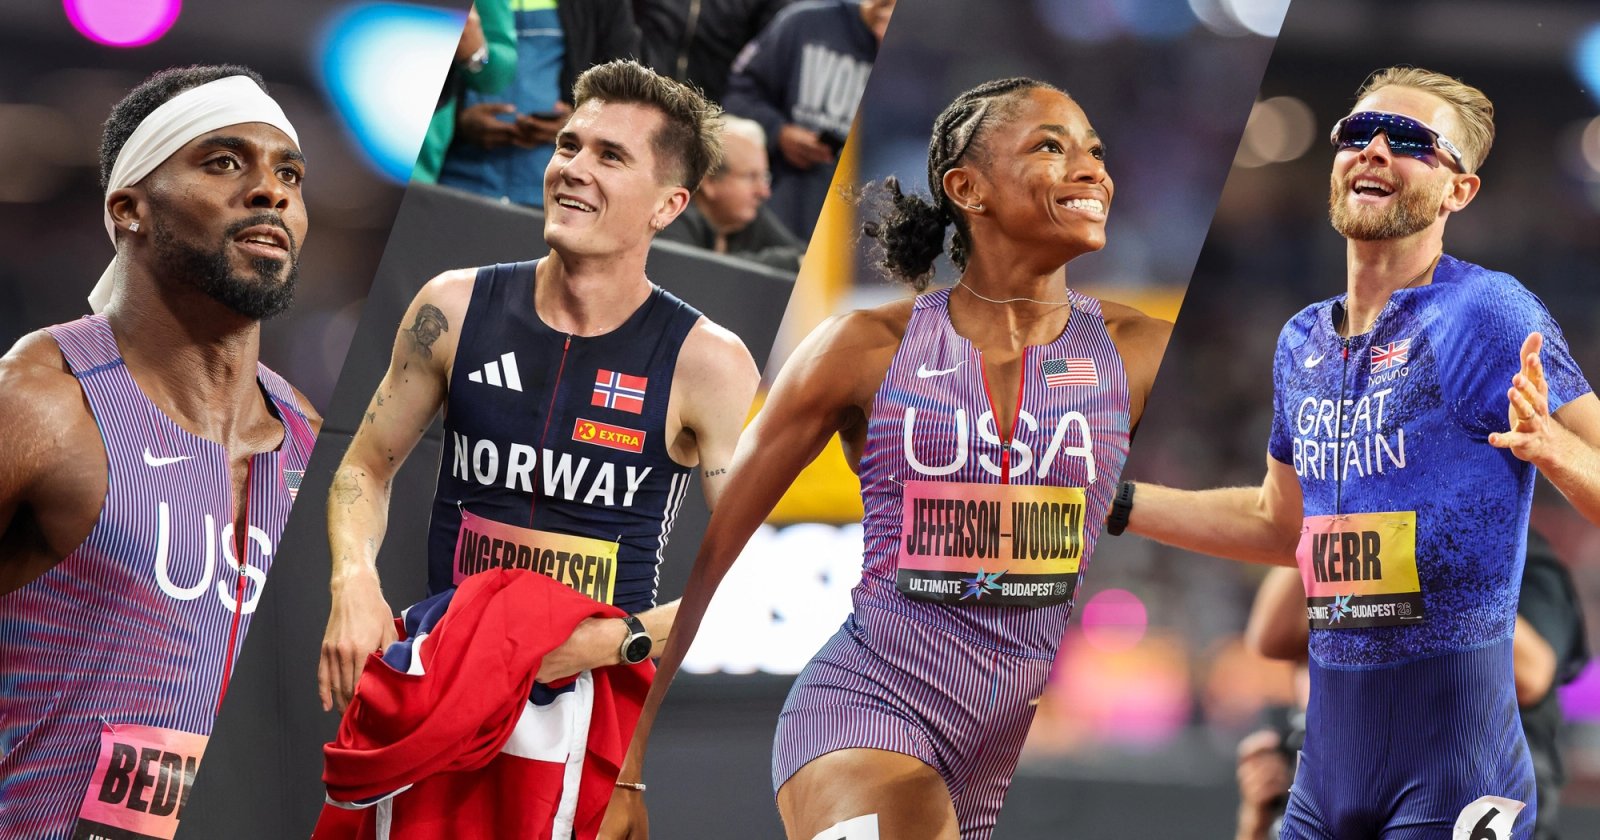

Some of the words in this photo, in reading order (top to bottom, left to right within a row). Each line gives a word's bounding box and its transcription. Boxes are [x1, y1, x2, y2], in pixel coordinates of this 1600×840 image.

[599, 430, 639, 446] EXTRA
[1298, 388, 1392, 438] GREAT
[452, 431, 652, 507] NORWAY
[904, 407, 1096, 482] USA
[1293, 428, 1406, 481] BRITAIN
[907, 498, 1081, 561] JEFFERSON-WOODEN
[155, 502, 272, 614] US
[1312, 531, 1382, 583] KERR
[909, 578, 961, 594] ULTIMATE
[1002, 582, 1054, 596] BUDAPEST
[1351, 603, 1396, 618] BUDAPEST
[1397, 602, 1412, 616] 26
[1469, 807, 1500, 840] 6
